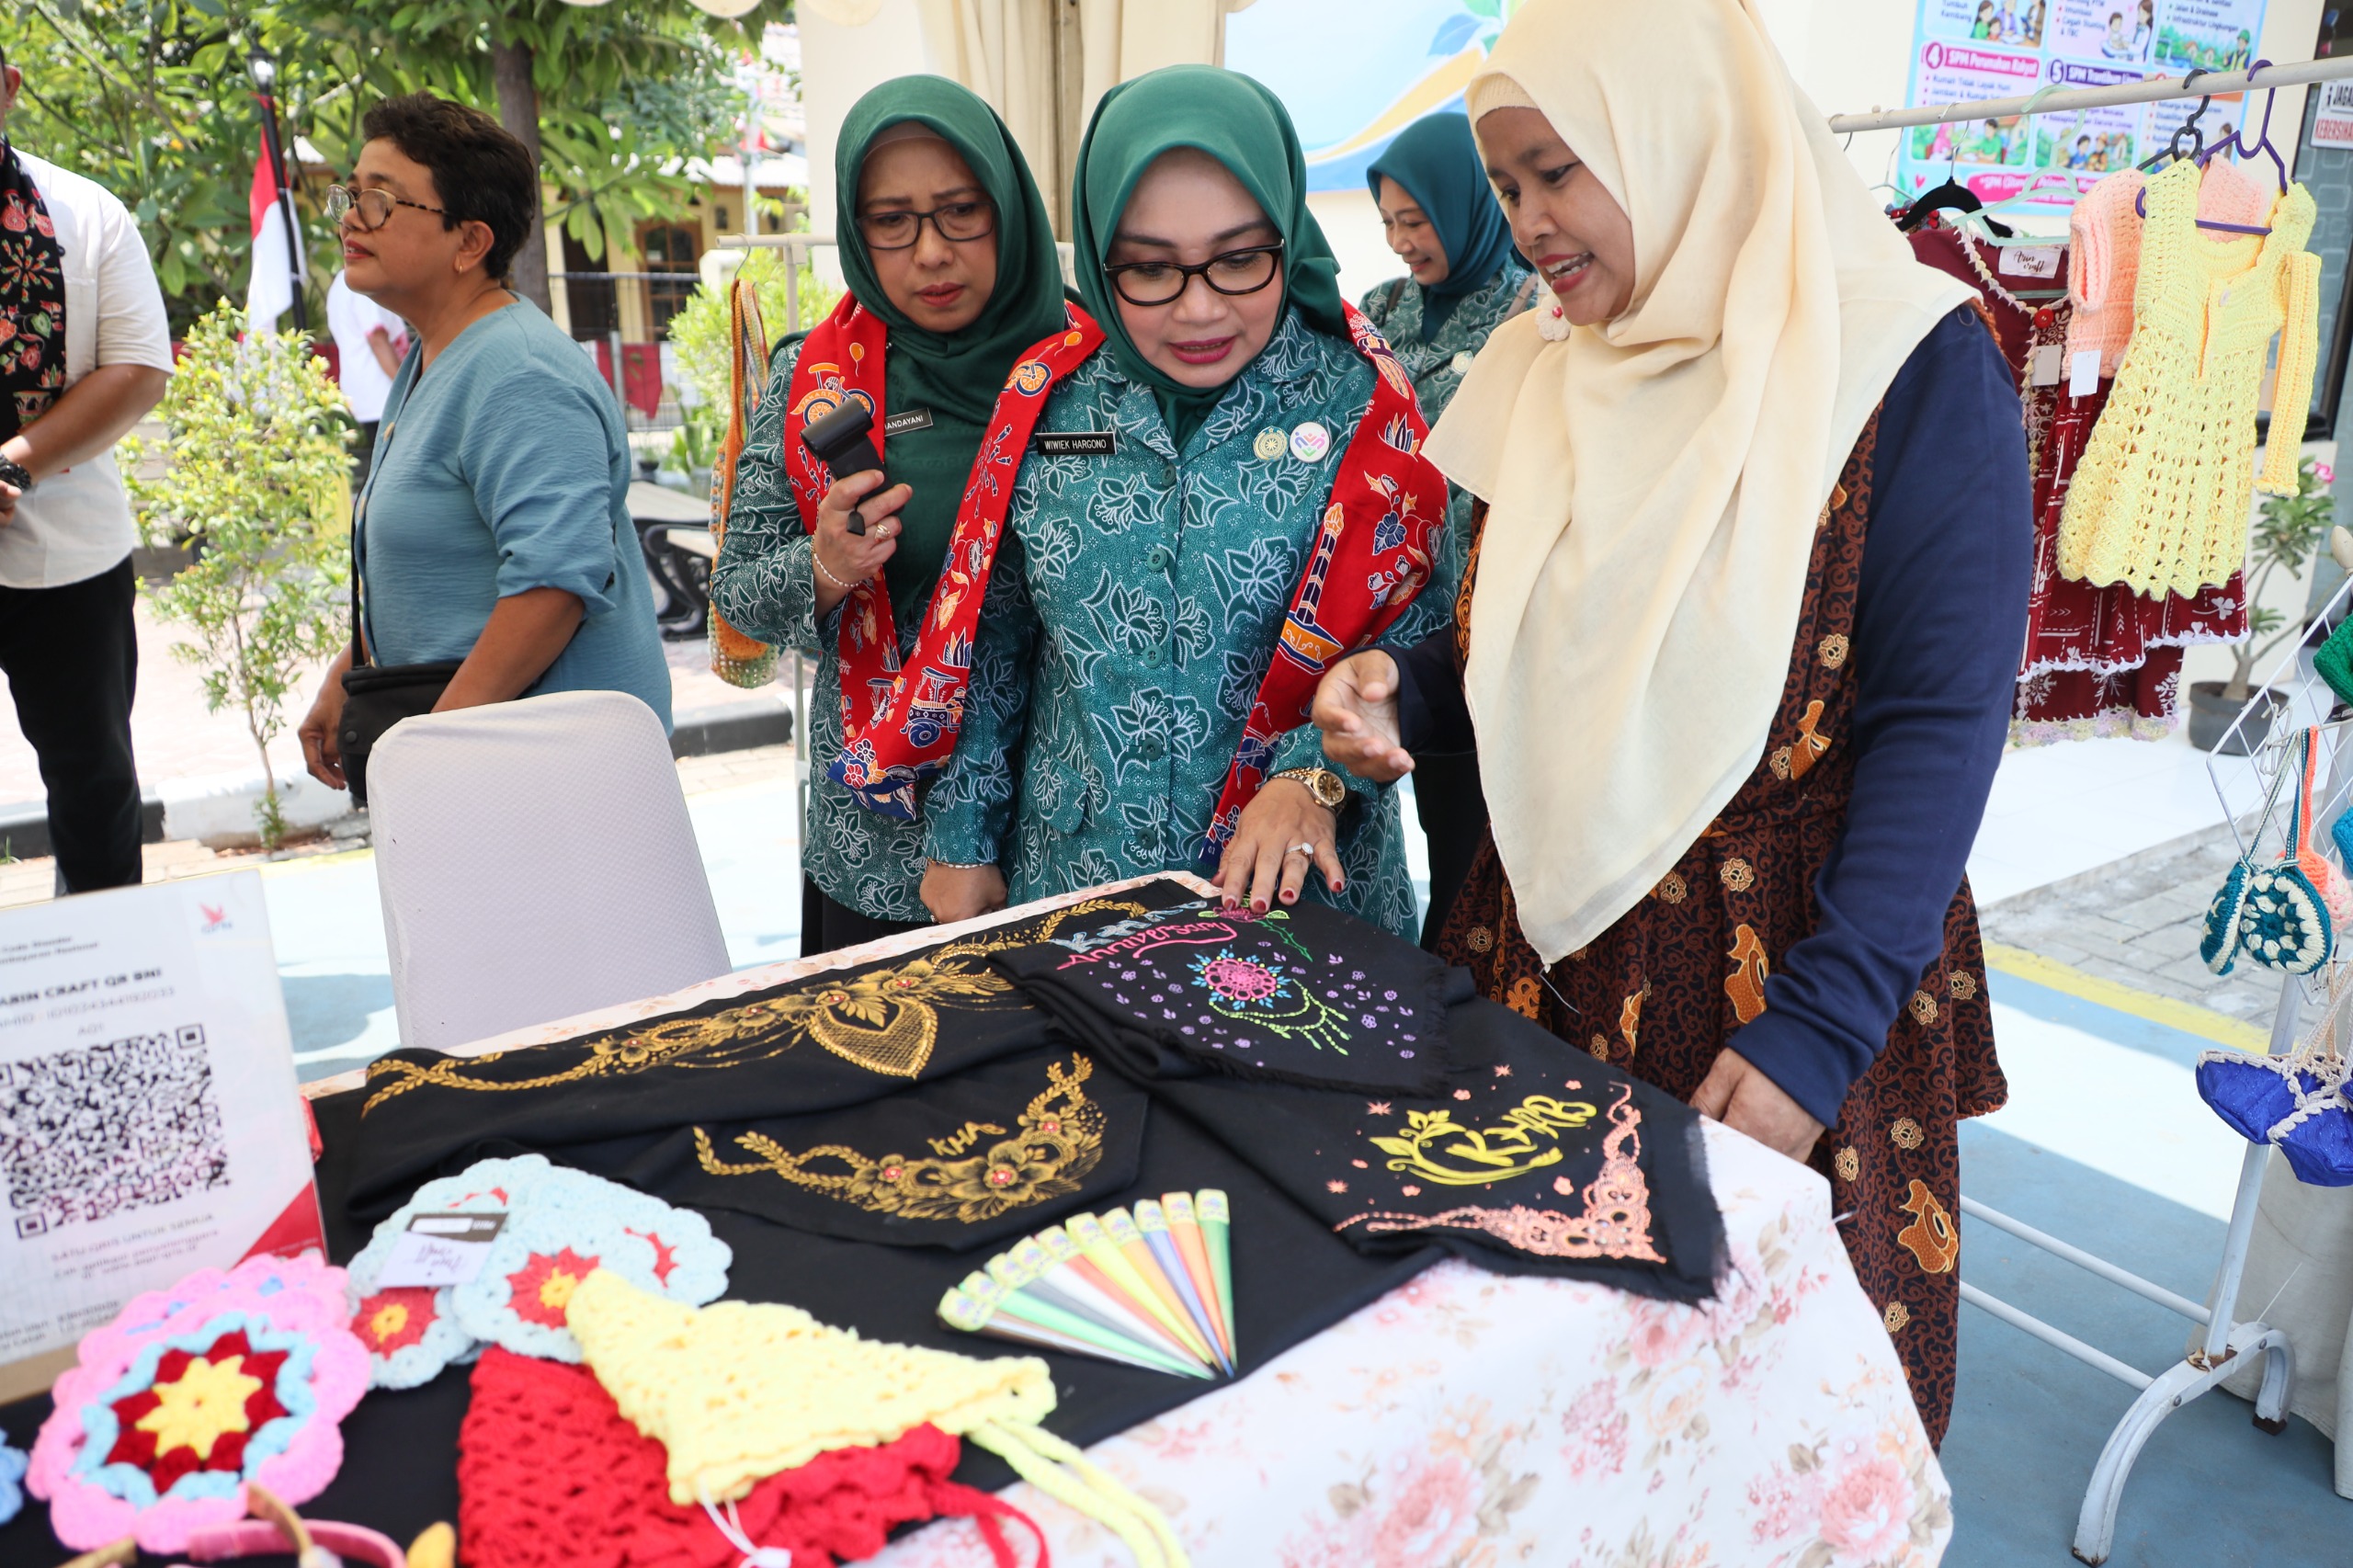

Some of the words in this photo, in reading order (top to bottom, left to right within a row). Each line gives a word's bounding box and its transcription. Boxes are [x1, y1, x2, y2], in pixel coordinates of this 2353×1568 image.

[1927, 44, 1940, 67] 4
[1044, 439, 1070, 450] WIWIEK
[1072, 438, 1107, 449] HARGONO
[1057, 921, 1237, 971] Anniversary
[45, 980, 99, 998] CRAFT
